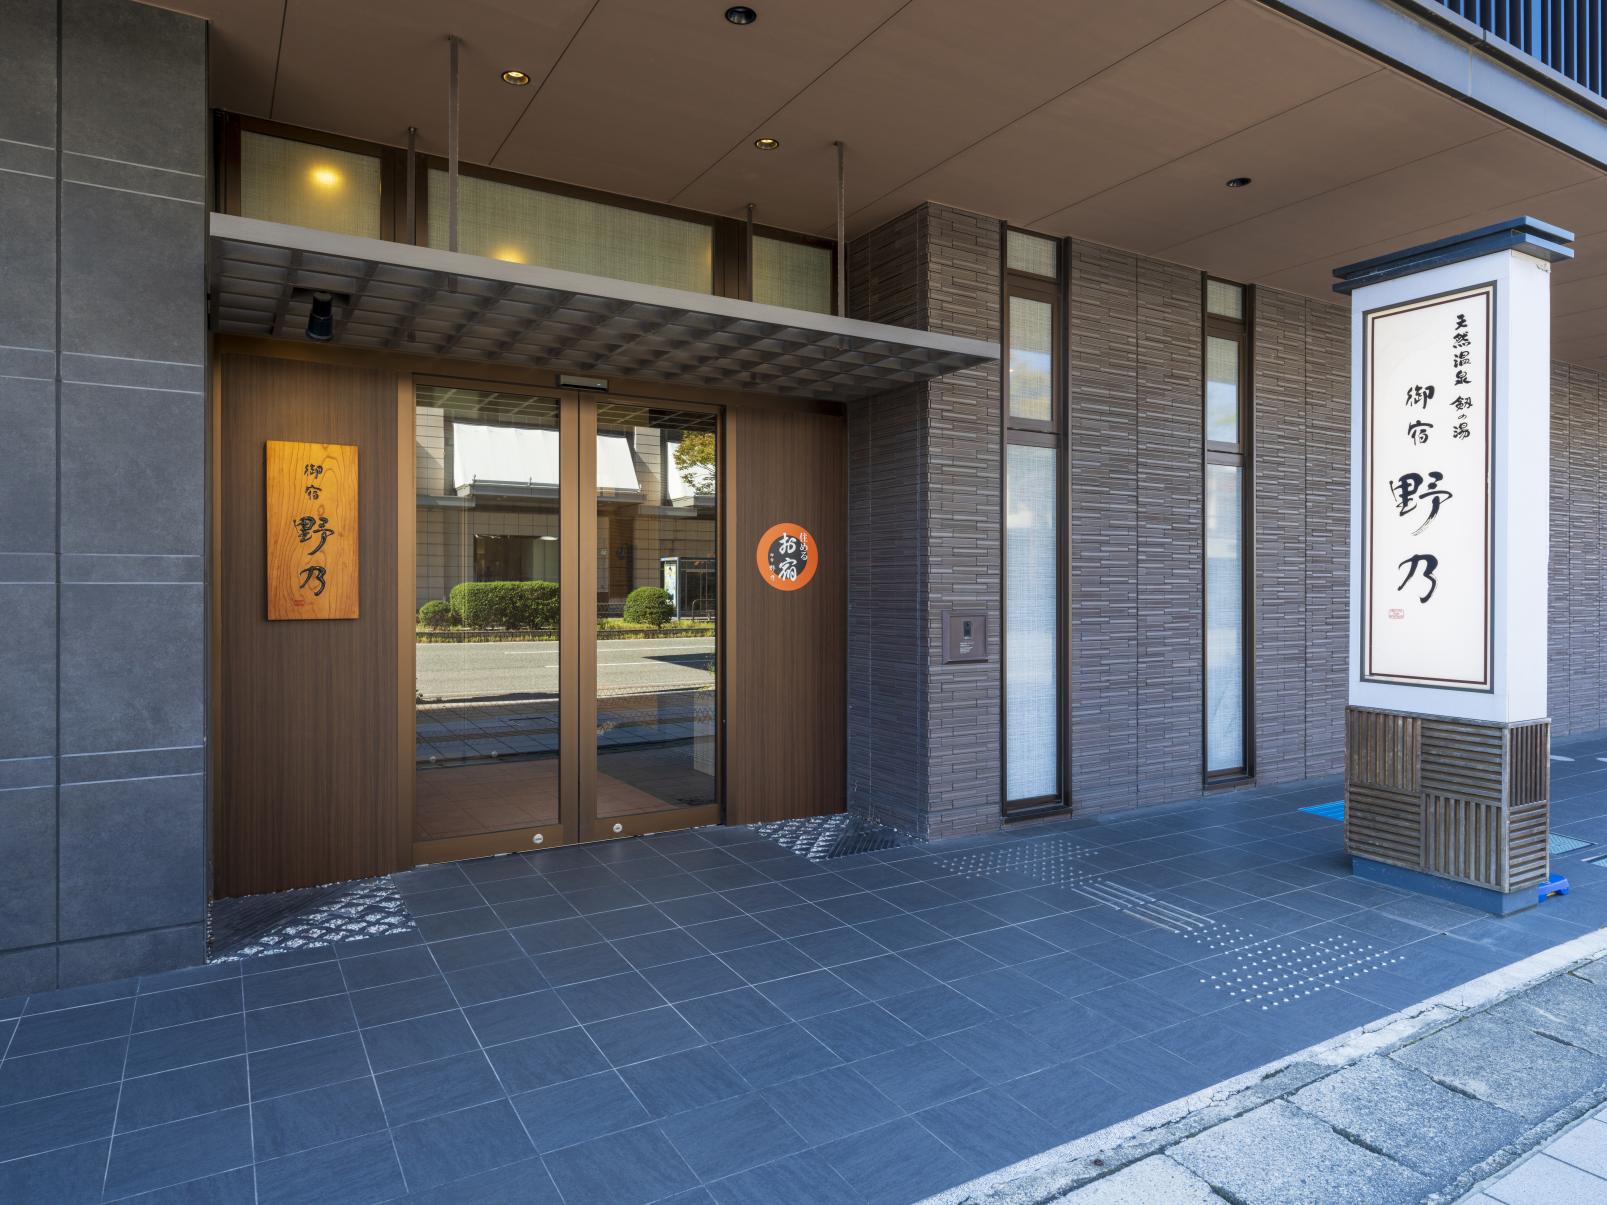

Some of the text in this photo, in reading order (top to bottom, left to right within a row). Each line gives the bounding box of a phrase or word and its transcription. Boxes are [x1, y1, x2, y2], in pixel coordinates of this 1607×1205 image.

[1452, 314, 1473, 387] 天然温泉
[293, 463, 335, 597] 御宿 野乃
[1389, 384, 1454, 604] 御宿 野乃
[778, 532, 798, 582] お宿
